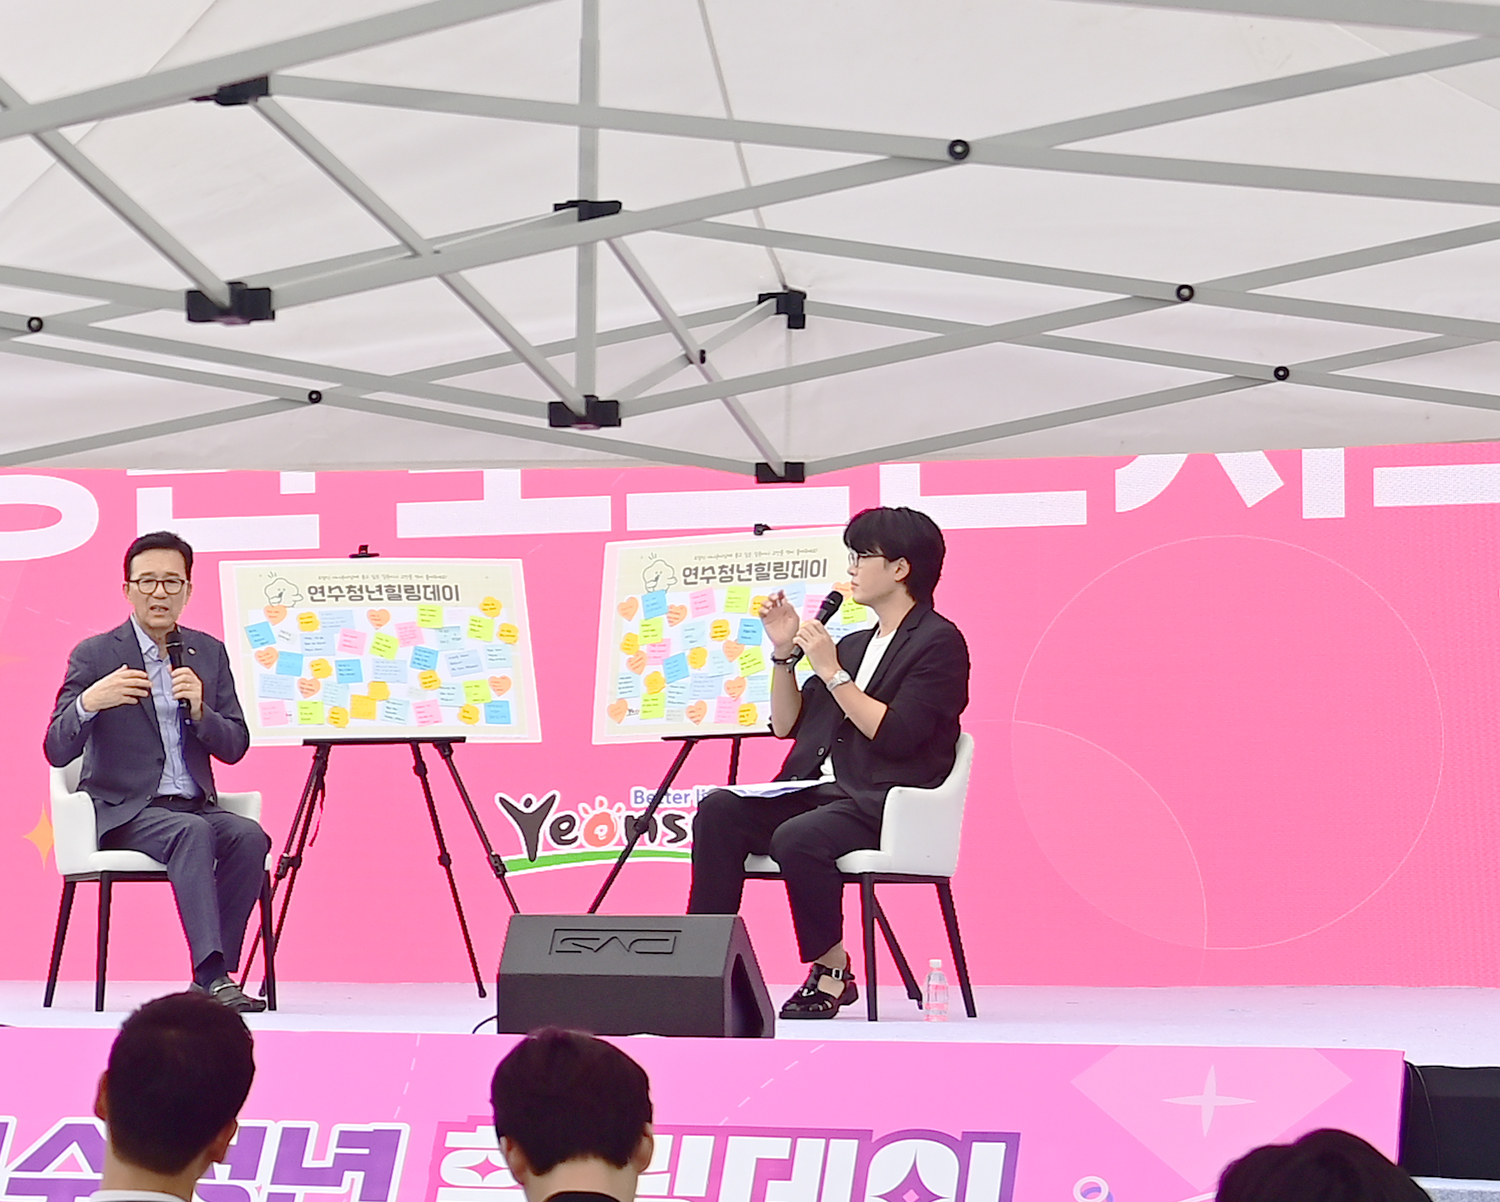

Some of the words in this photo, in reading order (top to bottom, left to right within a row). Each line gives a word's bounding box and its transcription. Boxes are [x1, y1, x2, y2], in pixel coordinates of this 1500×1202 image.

[683, 559, 827, 585] 연수청년힐링데이
[306, 583, 461, 602] 연수청년힐링데이
[633, 789, 690, 804] Beter
[498, 793, 690, 862] Yeons
